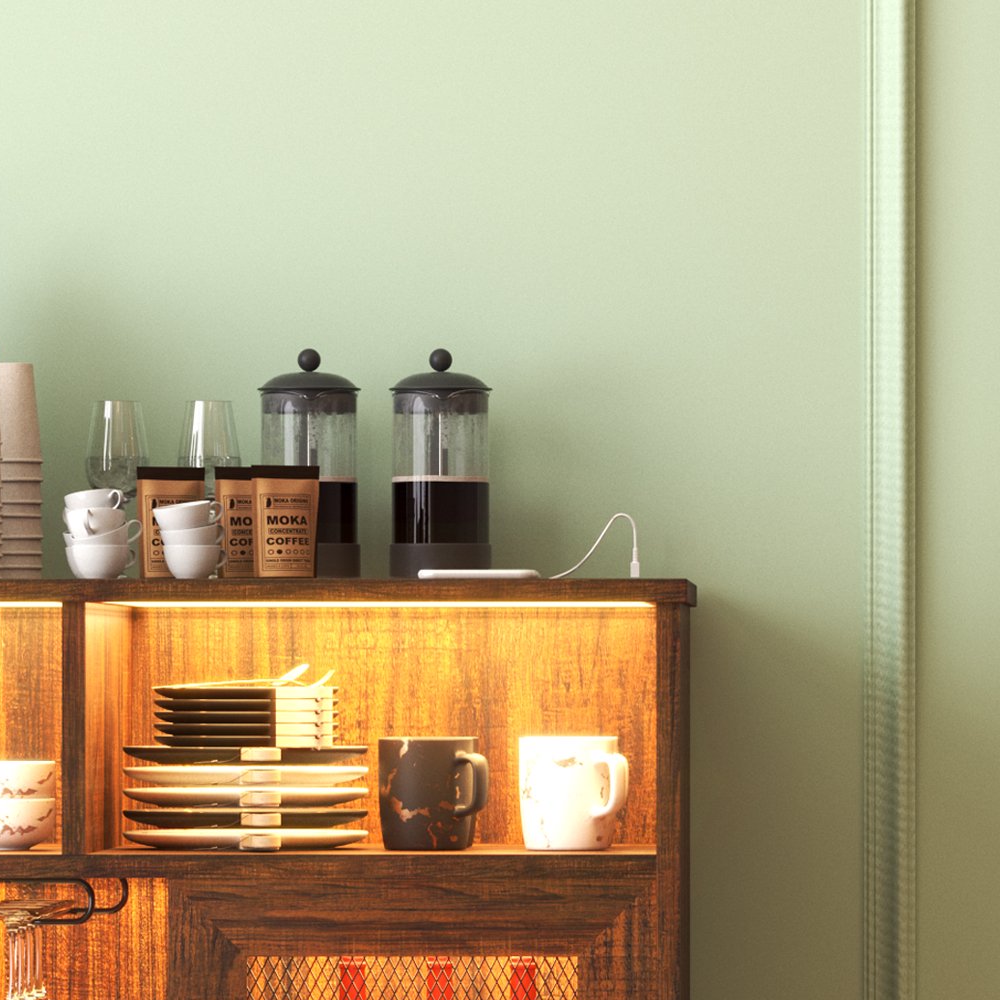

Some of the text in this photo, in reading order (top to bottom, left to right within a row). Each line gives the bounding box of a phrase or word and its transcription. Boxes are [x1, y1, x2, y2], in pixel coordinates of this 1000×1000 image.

[230, 516, 253, 526] MO
[267, 515, 307, 525] MOKA
[266, 537, 310, 546] COFFEE
